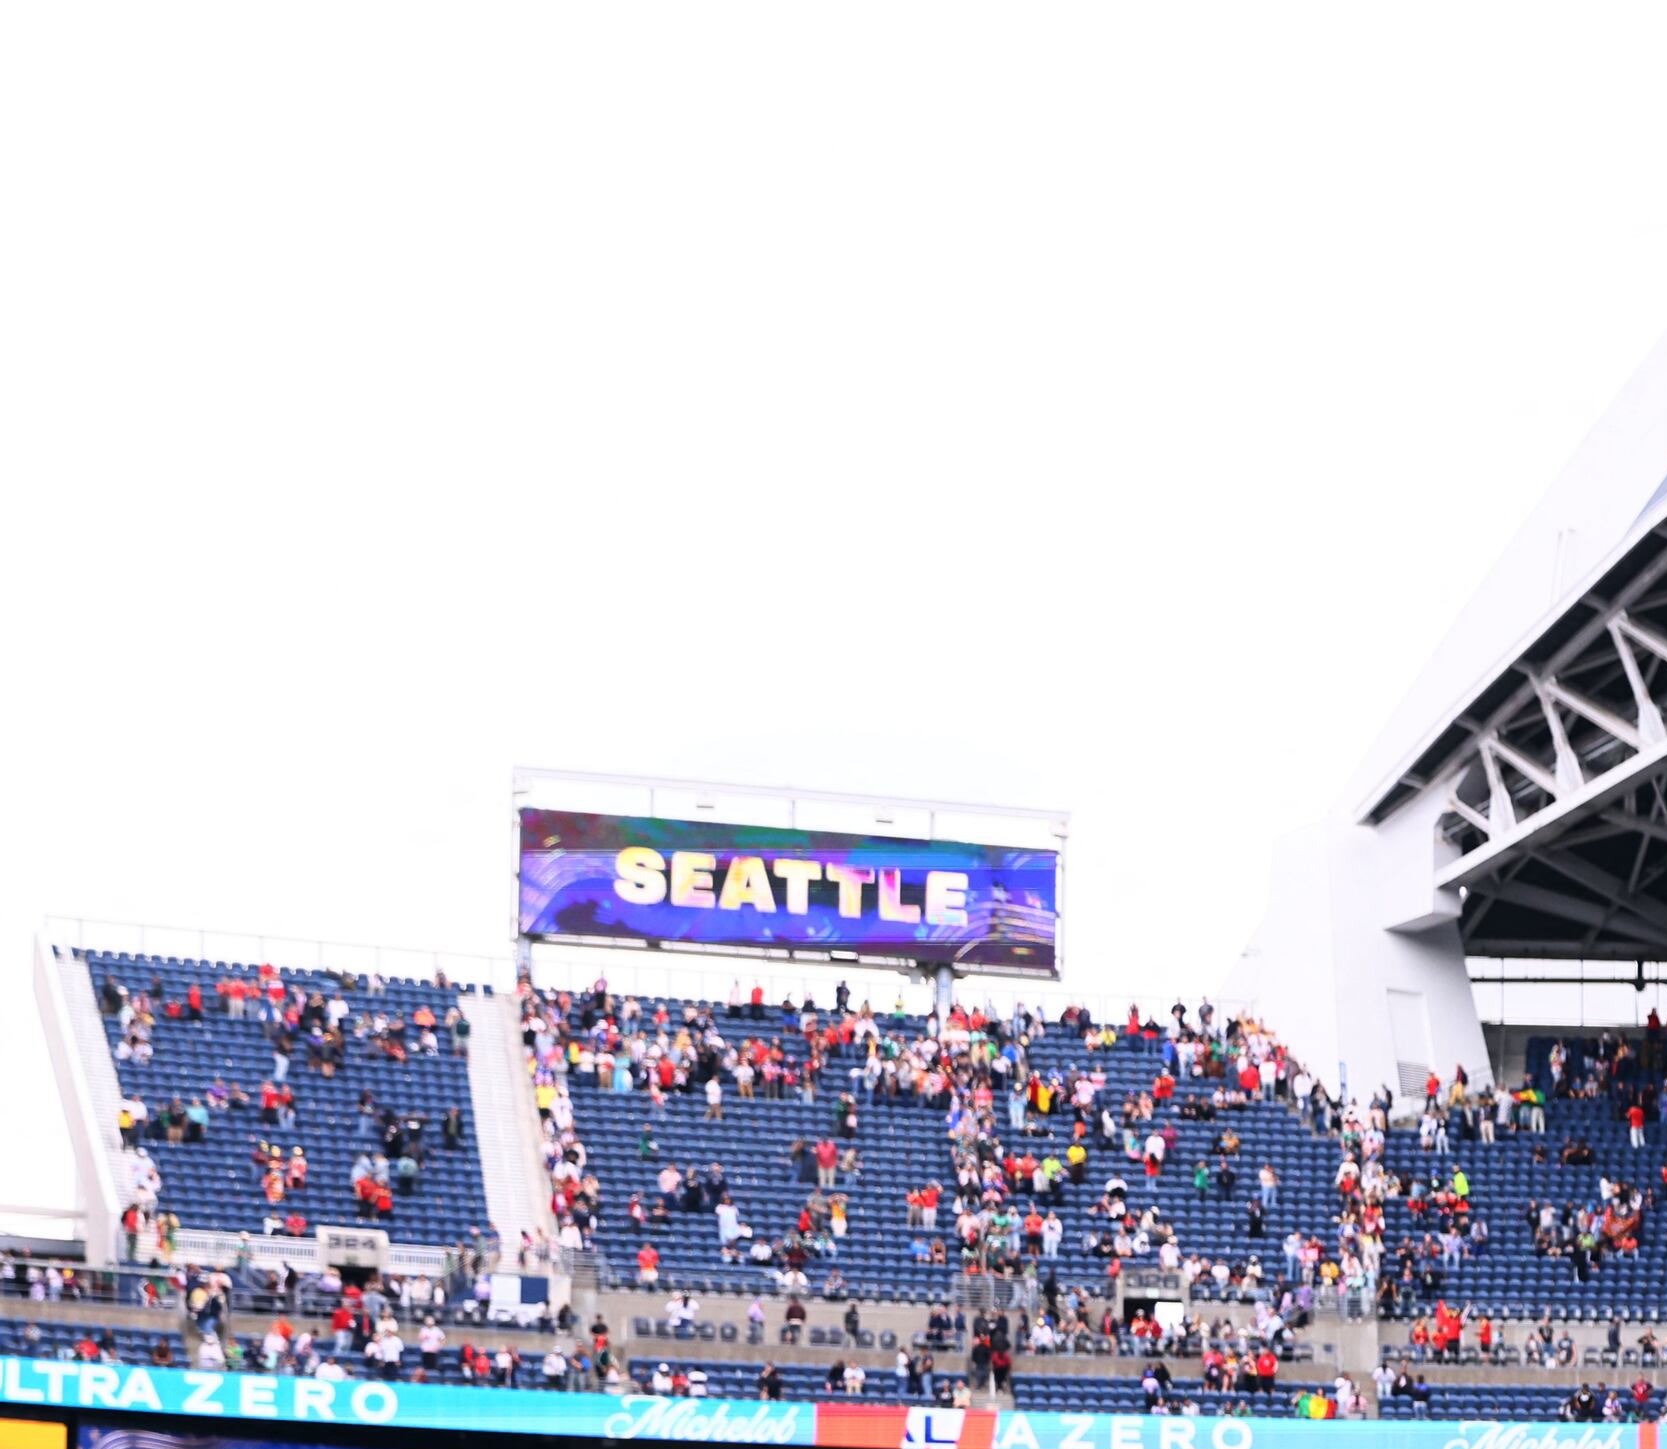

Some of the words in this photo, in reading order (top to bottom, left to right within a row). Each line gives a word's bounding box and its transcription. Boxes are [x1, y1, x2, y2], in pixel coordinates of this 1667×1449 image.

[613, 846, 968, 927] SEATTLE
[0, 1362, 162, 1410] LTRA
[183, 1371, 398, 1423] ZERO
[604, 1395, 799, 1444] Michelob
